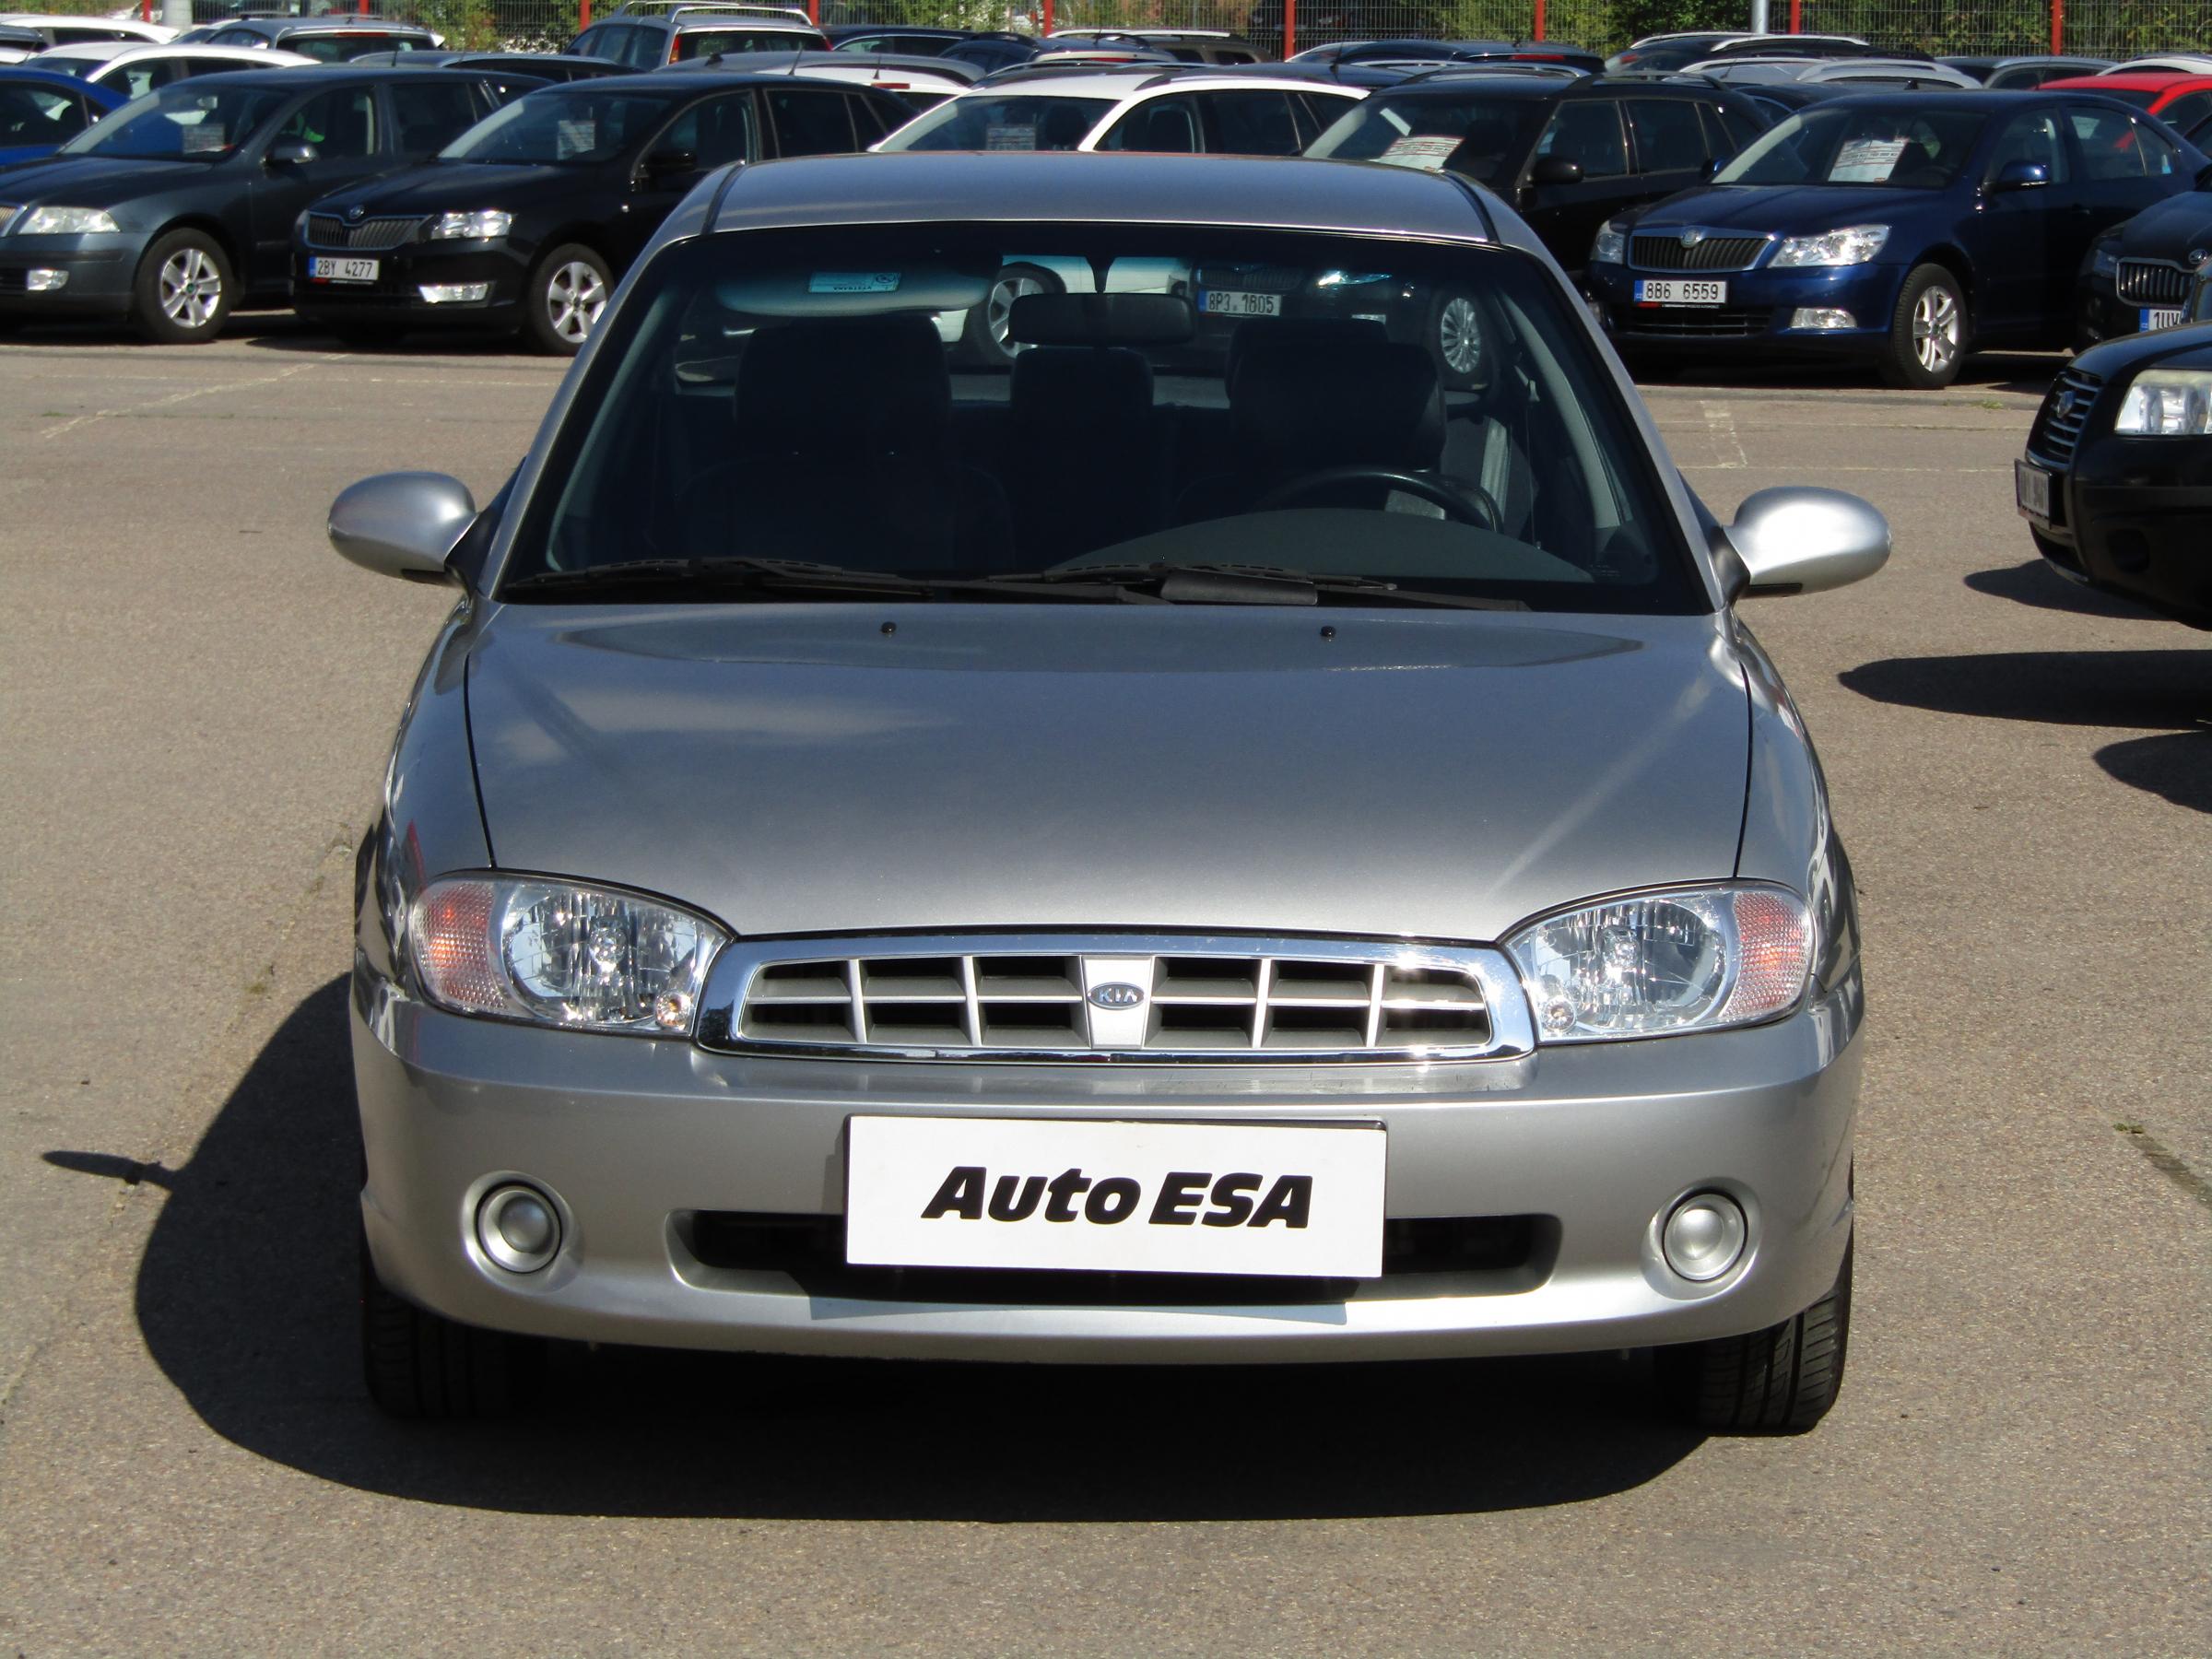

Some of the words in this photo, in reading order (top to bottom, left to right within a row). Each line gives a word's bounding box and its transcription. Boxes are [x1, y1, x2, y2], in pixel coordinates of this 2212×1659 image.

[317, 260, 336, 276] 2BY
[345, 260, 373, 278] 4277
[1646, 282, 1672, 300] 8B6
[1683, 283, 1719, 300] 6559
[1099, 988, 1138, 1004] KIA
[920, 1166, 1143, 1226] Auto
[1147, 1171, 1314, 1230] ESA
